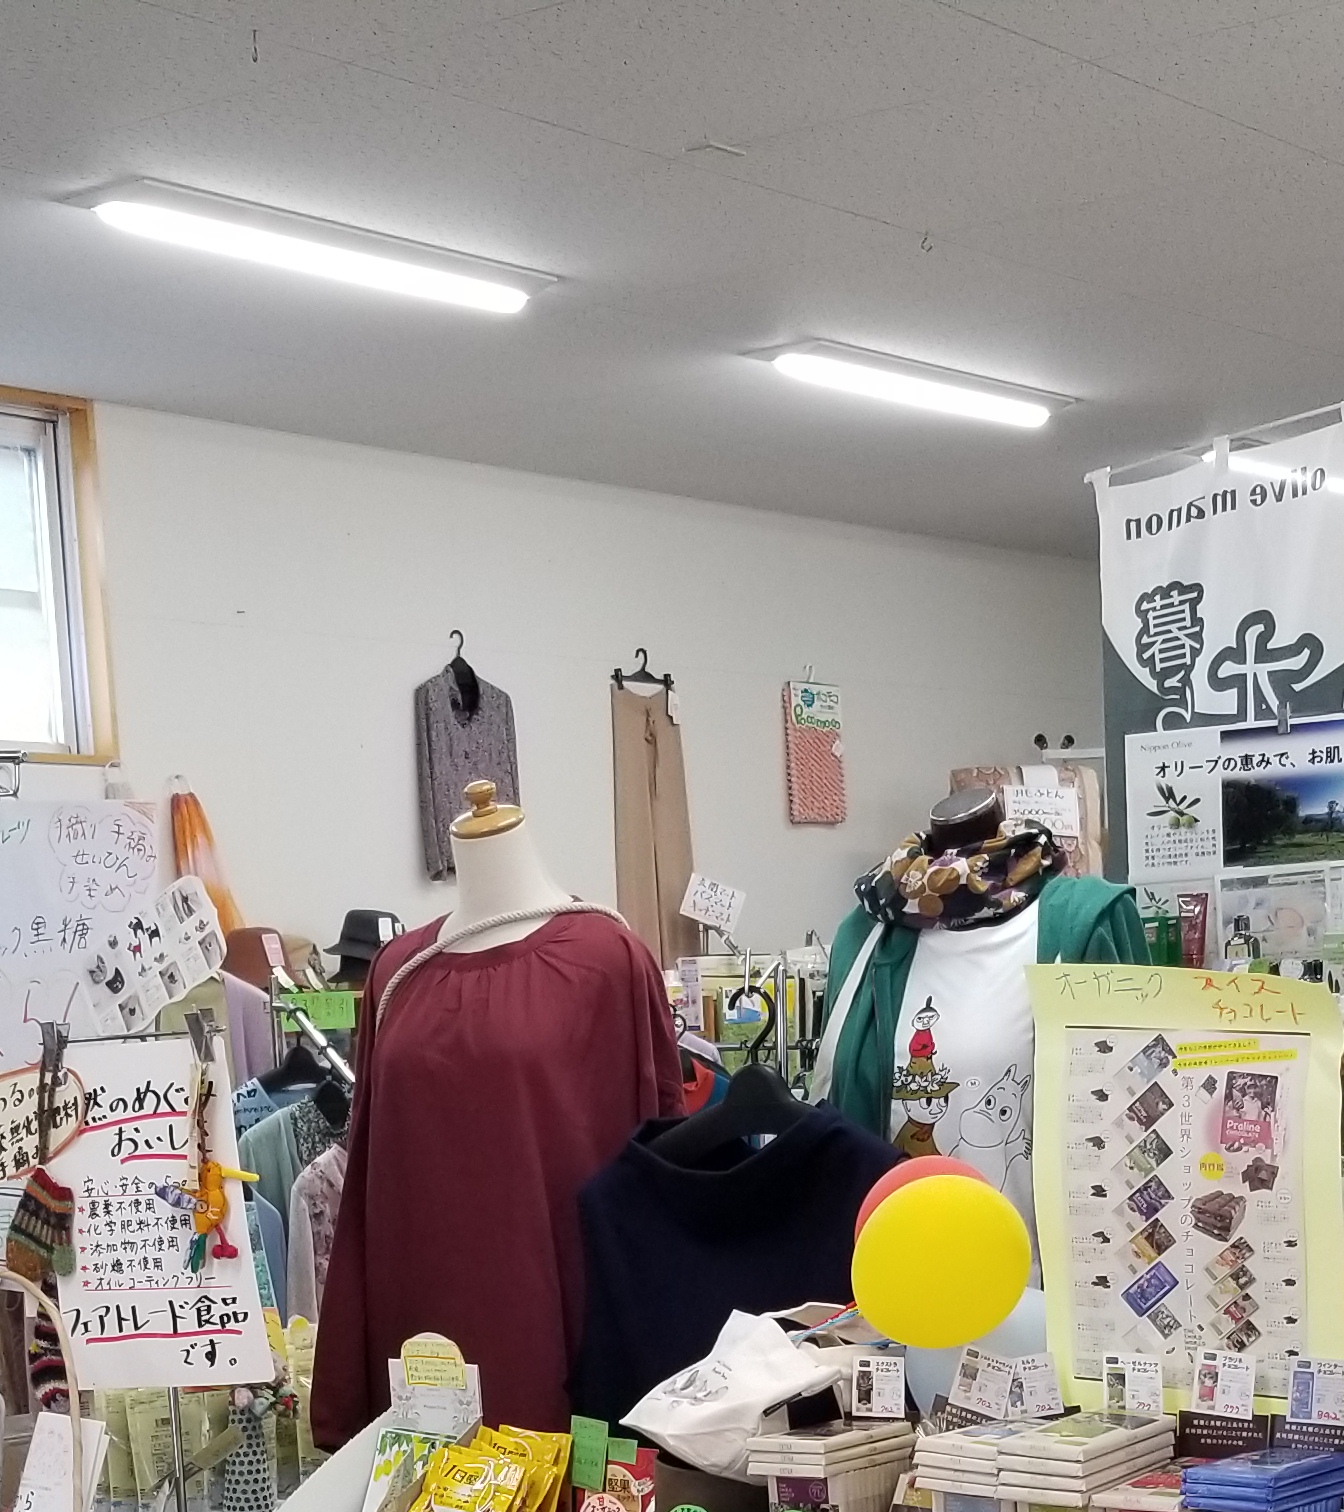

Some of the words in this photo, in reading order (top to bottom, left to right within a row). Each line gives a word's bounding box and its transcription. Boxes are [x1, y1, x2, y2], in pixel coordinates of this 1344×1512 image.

[111, 819, 157, 863] 手編み
[72, 849, 138, 879] せいひん
[1056, 972, 1163, 1002] オーガニック
[1194, 974, 1281, 997] スイス
[1212, 999, 1307, 1025] チョコレート
[1226, 1119, 1261, 1133] Praline
[88, 1199, 157, 1216] 農薬不使用
[86, 1214, 193, 1237] 化学肥料不使用
[89, 1235, 181, 1256] 添加物不使用
[92, 1252, 164, 1275] 砂糖不使用
[63, 1295, 250, 1338] フェアトレード食品
[180, 1338, 239, 1368] です。
